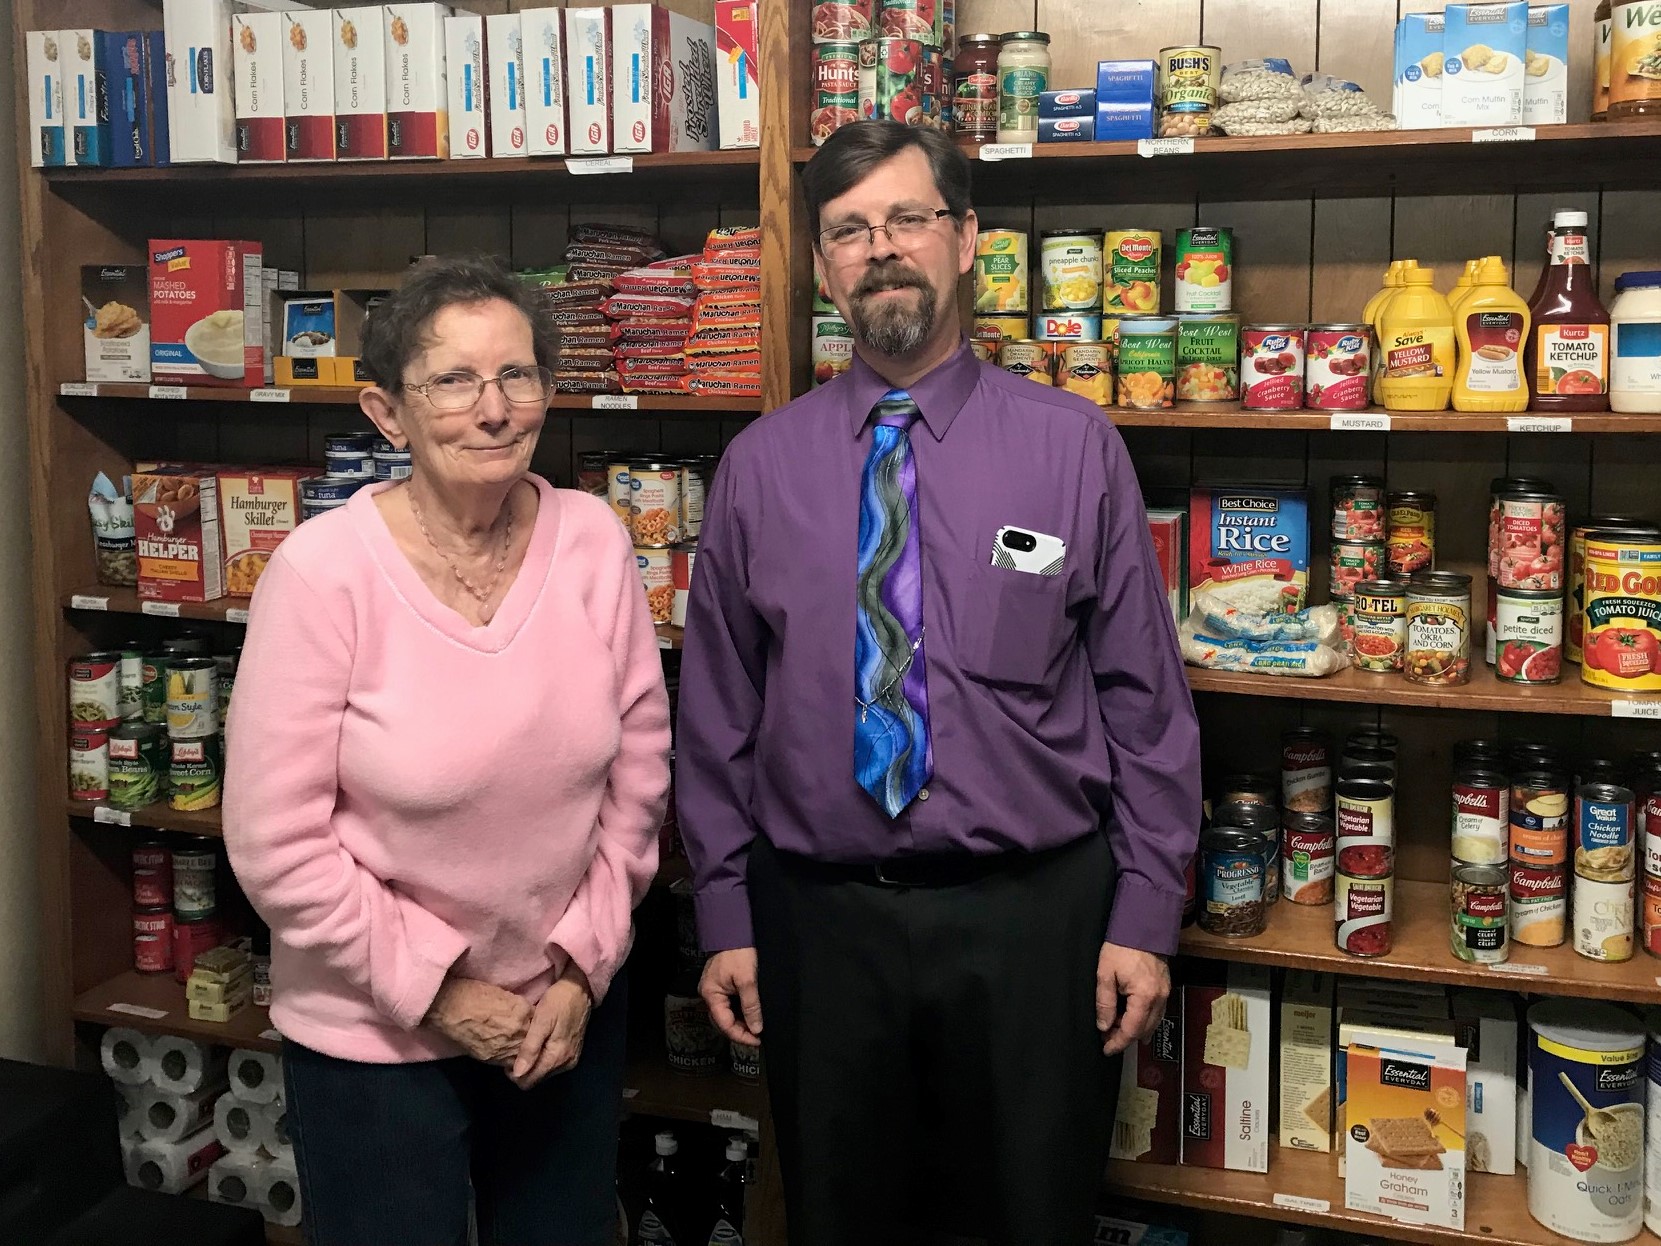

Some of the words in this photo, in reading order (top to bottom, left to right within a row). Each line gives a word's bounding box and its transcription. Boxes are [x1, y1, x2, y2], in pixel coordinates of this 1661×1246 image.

[1170, 57, 1209, 73] BUSH'S
[250, 62, 258, 88] Flakes
[818, 65, 860, 82] Hunt's
[662, 65, 674, 100] IGA
[1164, 87, 1213, 102] Organic
[250, 92, 258, 112] Corn
[823, 97, 856, 105] Traditional
[1421, 102, 1440, 110] Corn
[1106, 114, 1142, 122] SPAGHETTI
[548, 126, 556, 143] IGA
[591, 126, 599, 142] IGA
[635, 123, 643, 140] IGA
[469, 132, 477, 148] IGA
[513, 131, 522, 147] IGA
[985, 147, 1027, 155] SPAGHETTI
[1566, 237, 1582, 245] Kurtz
[155, 249, 184, 263] Shoppers
[571, 248, 606, 259] Maruchan
[608, 253, 631, 262] Ramen
[1049, 257, 1079, 266] pineapple
[577, 268, 611, 279] Maruchan
[153, 281, 186, 290] MASHED
[153, 290, 197, 300] POTATOES
[572, 288, 598, 297] Ramen
[617, 303, 651, 311] Maruchan
[702, 310, 740, 319] Maruchan
[624, 328, 661, 336] Maruchan
[1046, 319, 1082, 336] Dole
[1203, 325, 1232, 337] West
[1563, 329, 1586, 337] Kurtz
[695, 332, 731, 340] Maruchan
[1190, 337, 1215, 346] FRUIT
[1265, 336, 1287, 346] Ruby
[1394, 334, 1424, 348] Save
[1145, 338, 1173, 349] West
[1341, 338, 1361, 347] Ruby
[1551, 342, 1595, 351] TOMATO
[155, 349, 183, 358] ORIGINAL
[1183, 346, 1222, 356] COCKTAIL
[1394, 346, 1426, 360] YELLOW
[1549, 351, 1598, 361] KETCHUP
[695, 360, 731, 368] Maruchan
[1389, 353, 1430, 369] MUSTARD
[1263, 377, 1284, 388] Jellied
[1339, 378, 1359, 388] Jellied
[1257, 386, 1290, 398] Cranberry
[1264, 392, 1285, 402] Sauce
[1332, 386, 1364, 400] Cranberry
[1340, 393, 1359, 403] Sauce
[1342, 420, 1383, 428] MUSTARD
[331, 443, 347, 451] tuna
[318, 491, 336, 499] tuna
[230, 495, 288, 515] Hamburger
[1221, 498, 1242, 508] Best
[1243, 498, 1276, 510] Choice
[244, 511, 275, 526] Skillet
[1218, 512, 1277, 527] Instant
[1507, 524, 1538, 533] TOMATOES
[1217, 526, 1291, 552] Rice
[138, 540, 199, 561] HELPER
[1221, 563, 1253, 575] White
[1255, 559, 1277, 569] Rice
[1586, 567, 1621, 593] RED
[1372, 599, 1398, 612] TEL
[1622, 599, 1657, 609] SQUEEZED
[1594, 605, 1636, 618] TOMATO
[1503, 624, 1528, 634] petite
[1529, 624, 1553, 635] diced
[1420, 633, 1443, 642] OKRA
[1413, 640, 1429, 648] AND
[1430, 641, 1454, 650] CORN
[1621, 652, 1649, 661] FRESH
[1632, 708, 1659, 716] JUICE
[189, 769, 212, 777] Corn
[1339, 810, 1370, 824] Vegetarian
[1589, 805, 1617, 818] Great
[1458, 815, 1477, 824] Cream
[1596, 813, 1617, 823] Value
[1340, 820, 1369, 833] Vegetable
[1460, 821, 1480, 832] Celery
[1588, 823, 1622, 835] Chicken
[1589, 831, 1620, 841] Noodle
[1216, 866, 1259, 879] PROGRESSO
[1221, 879, 1255, 890] Vegetable
[1513, 871, 1562, 891] Campbell's
[1349, 892, 1383, 904] Vegetarian
[1350, 900, 1382, 912] Vegetable
[1469, 900, 1503, 913] Campbell's
[1514, 908, 1534, 920] Cream
[1539, 902, 1561, 914] Chicken
[1293, 1009, 1316, 1020] meijer
[1162, 1017, 1174, 1061] Essential
[1600, 1053, 1625, 1063] Value
[1384, 1063, 1429, 1082] Essential
[1385, 1075, 1428, 1088] EVERYDAY
[1189, 1094, 1202, 1137] Essential
[1239, 1100, 1252, 1141] Saltine
[1390, 1171, 1419, 1185] Honey
[1379, 1179, 1429, 1198] Graham
[1576, 1181, 1613, 1195] Quick
